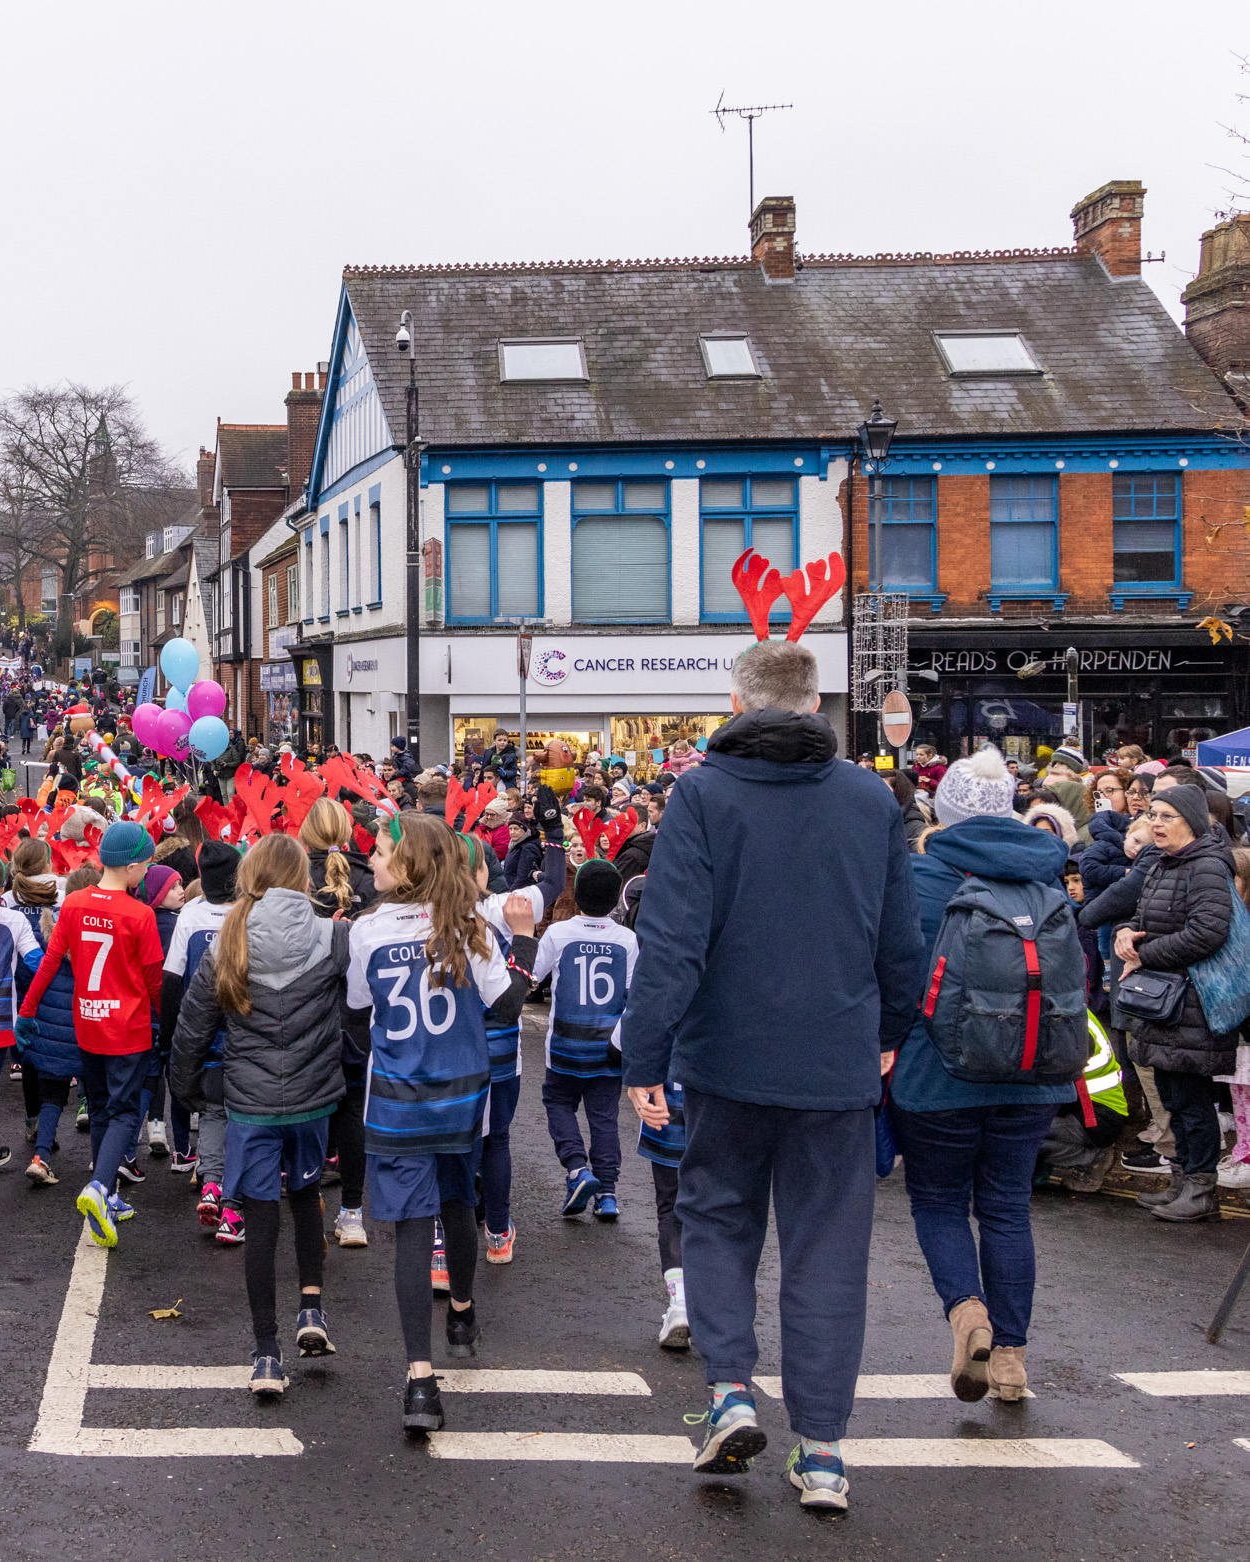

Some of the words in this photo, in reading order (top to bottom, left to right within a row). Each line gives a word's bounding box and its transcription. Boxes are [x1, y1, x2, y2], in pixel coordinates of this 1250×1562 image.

[574, 658, 634, 671] CANCER
[641, 657, 718, 671] RESEARCH
[723, 658, 734, 670] U
[931, 651, 997, 671] READS
[1007, 650, 1042, 671] OF
[1052, 650, 1172, 671] HRPENDEN
[83, 915, 113, 929] COLTS
[396, 913, 420, 921] VESEY
[579, 943, 612, 955] COLTS
[81, 931, 114, 991] 7
[574, 955, 615, 1006] 16
[79, 997, 120, 1009] YOUTH
[377, 962, 456, 1041] 36
[80, 1006, 110, 1018] TALK
